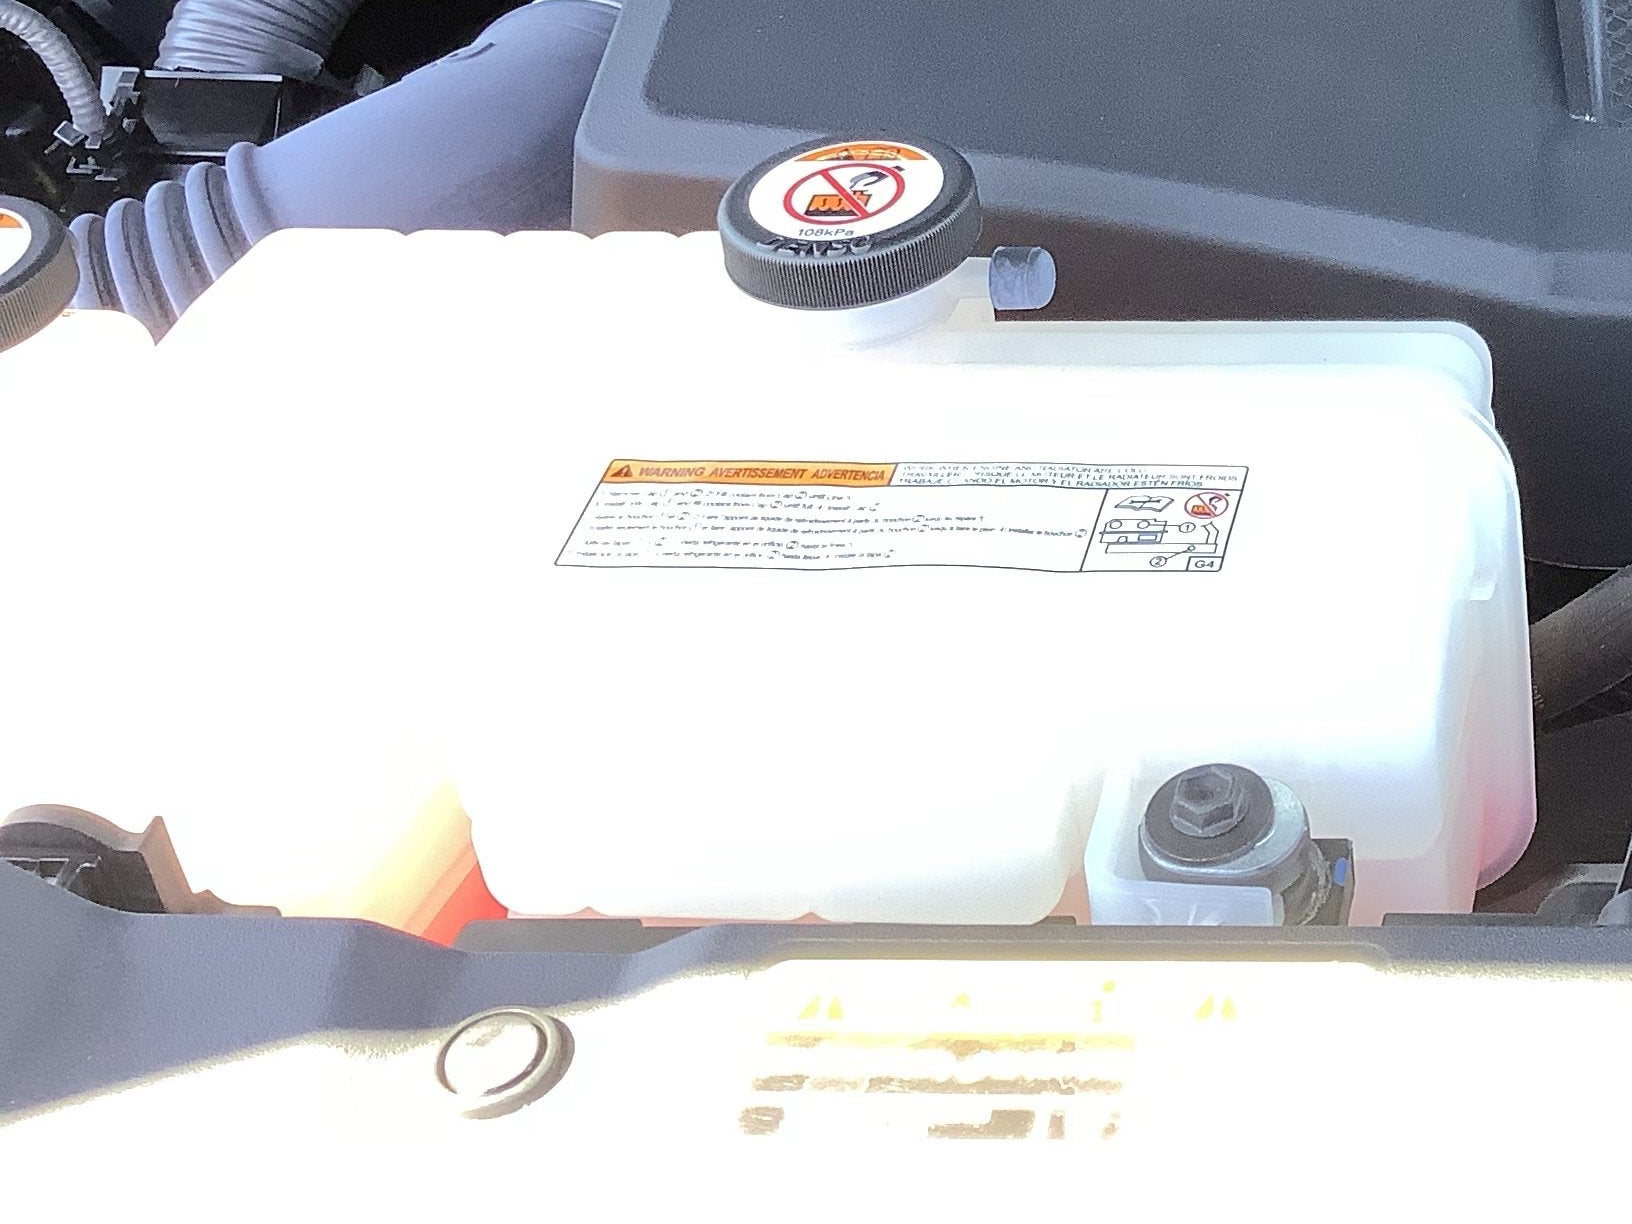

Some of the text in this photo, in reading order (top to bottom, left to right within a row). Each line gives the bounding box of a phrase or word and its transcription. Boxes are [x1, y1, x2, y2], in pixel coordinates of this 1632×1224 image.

[797, 228, 855, 237] 108kPa
[638, 467, 885, 481] WARNING AVERTISSEMENT ADVERTENCIA
[1194, 560, 1215, 569] G4
